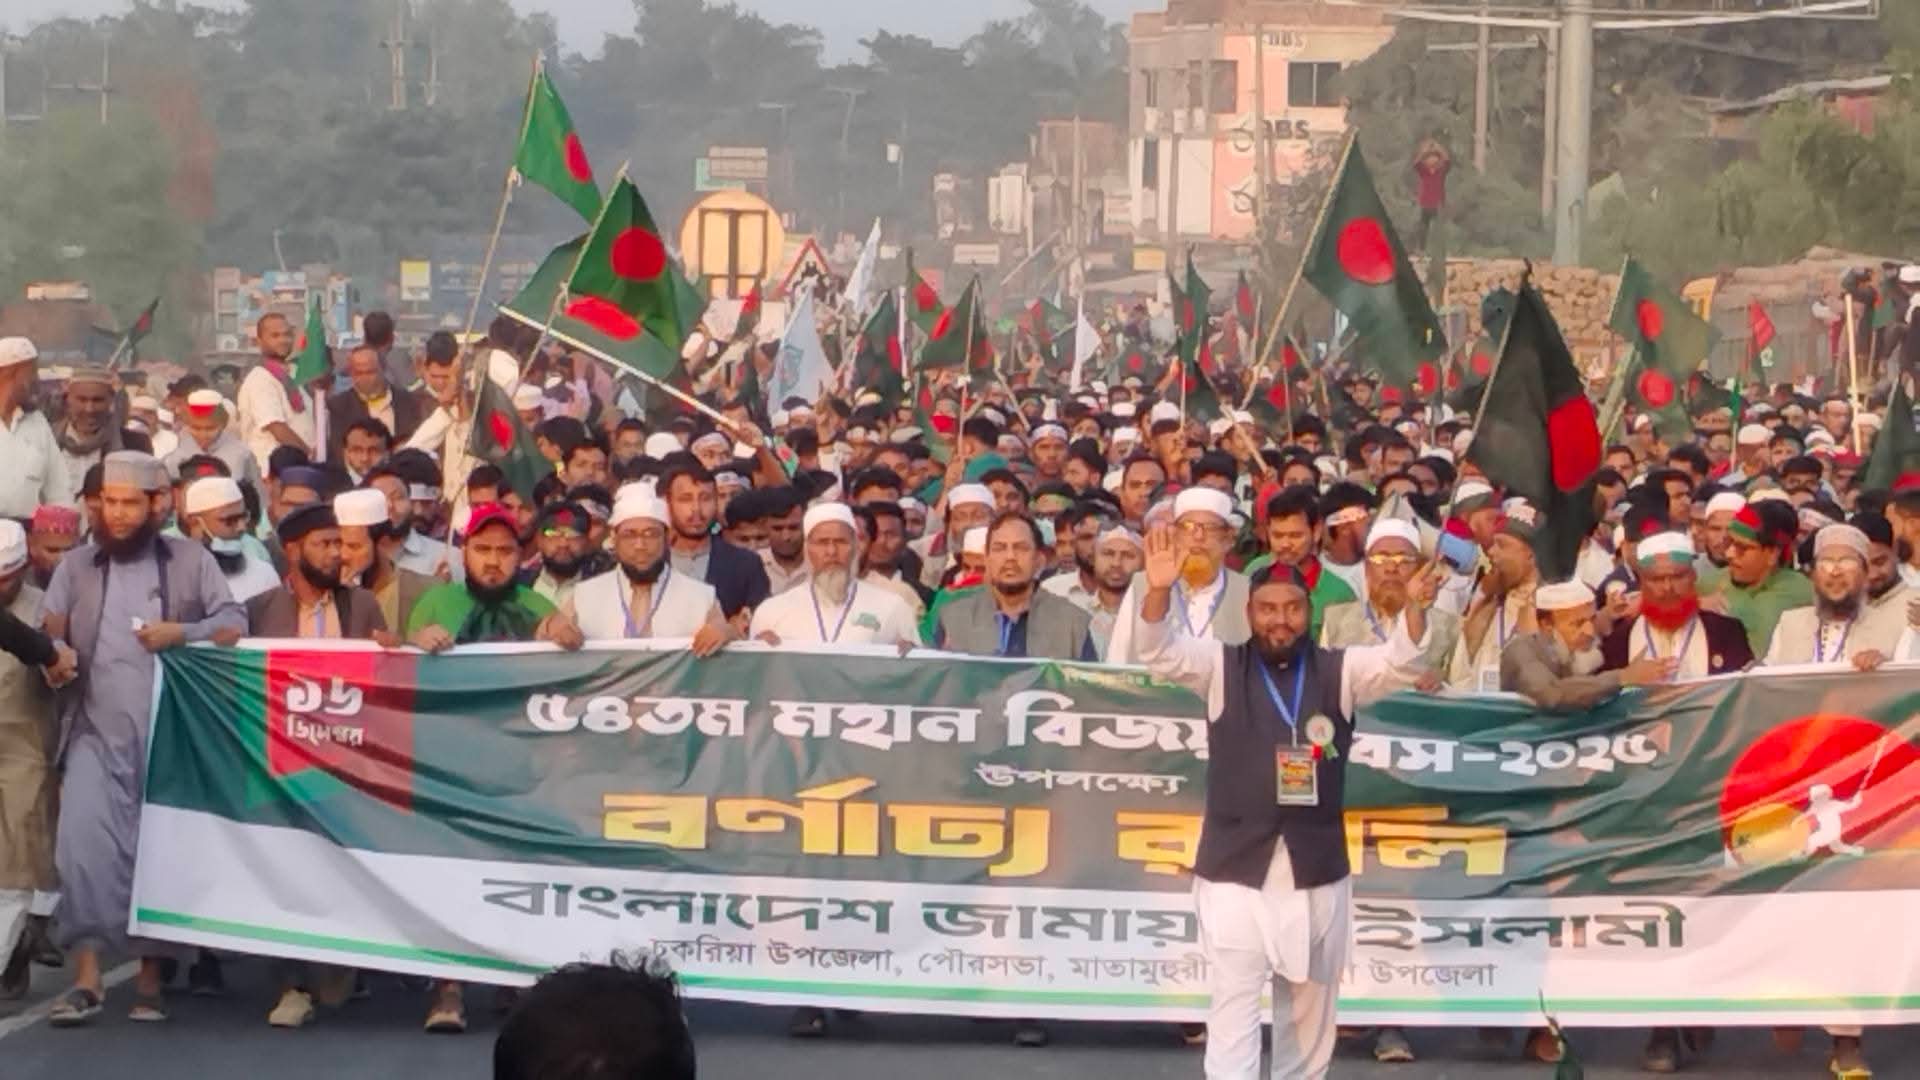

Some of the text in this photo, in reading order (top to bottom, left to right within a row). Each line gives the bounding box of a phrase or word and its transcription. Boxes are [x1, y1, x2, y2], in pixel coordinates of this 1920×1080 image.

[286, 672, 364, 716] ১৬
[526, 692, 748, 738] ৫৪তম
[771, 701, 981, 750] মহান
[1349, 731, 1658, 777] বস-২০২৫
[603, 777, 1050, 877] বর্ণাঢ্য
[482, 877, 893, 934] বাংলাদেশ
[1353, 901, 1687, 950] ইসলামী
[651, 934, 755, 966] চকরিয়া
[768, 938, 904, 975] উপজেলা,
[918, 947, 1056, 983] পৌরসভা,
[1068, 952, 1212, 986] মাতামুহুরী
[1369, 957, 1498, 988] উপজেলা
